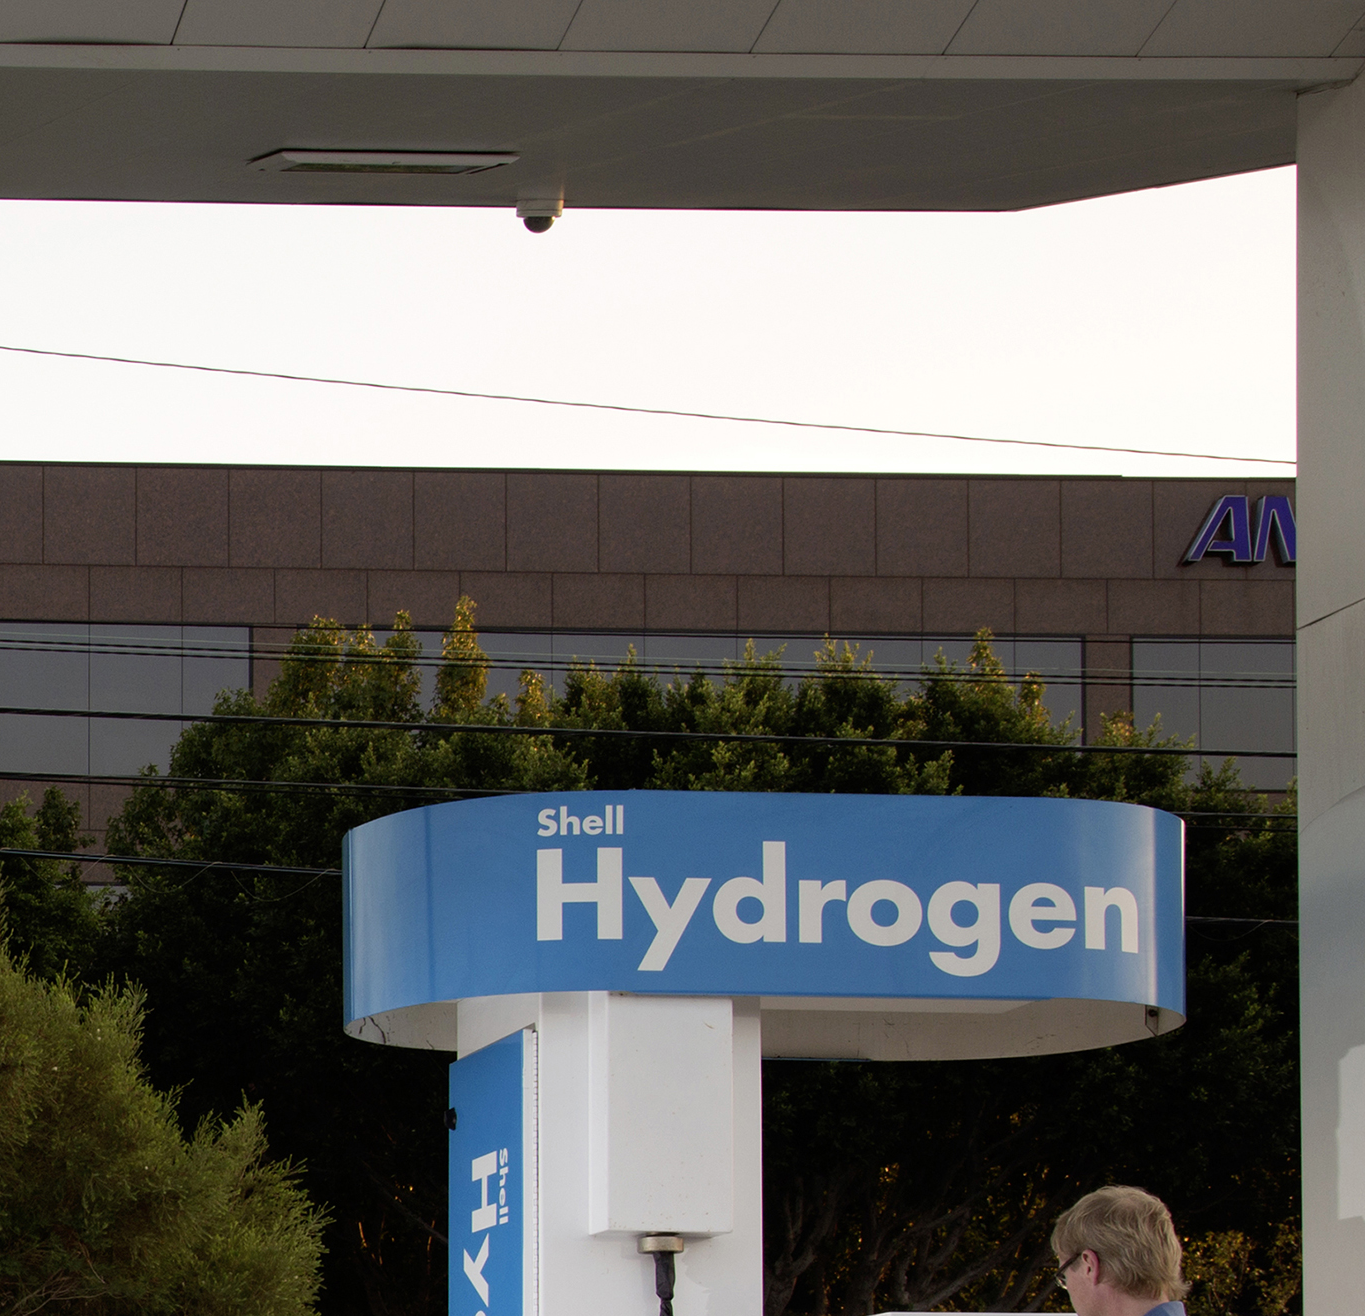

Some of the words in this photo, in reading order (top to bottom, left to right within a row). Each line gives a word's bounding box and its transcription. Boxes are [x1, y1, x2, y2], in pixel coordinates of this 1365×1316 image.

[536, 805, 625, 837] Shell
[536, 840, 1140, 977] Hydrogen
[498, 1147, 509, 1225] Shell
